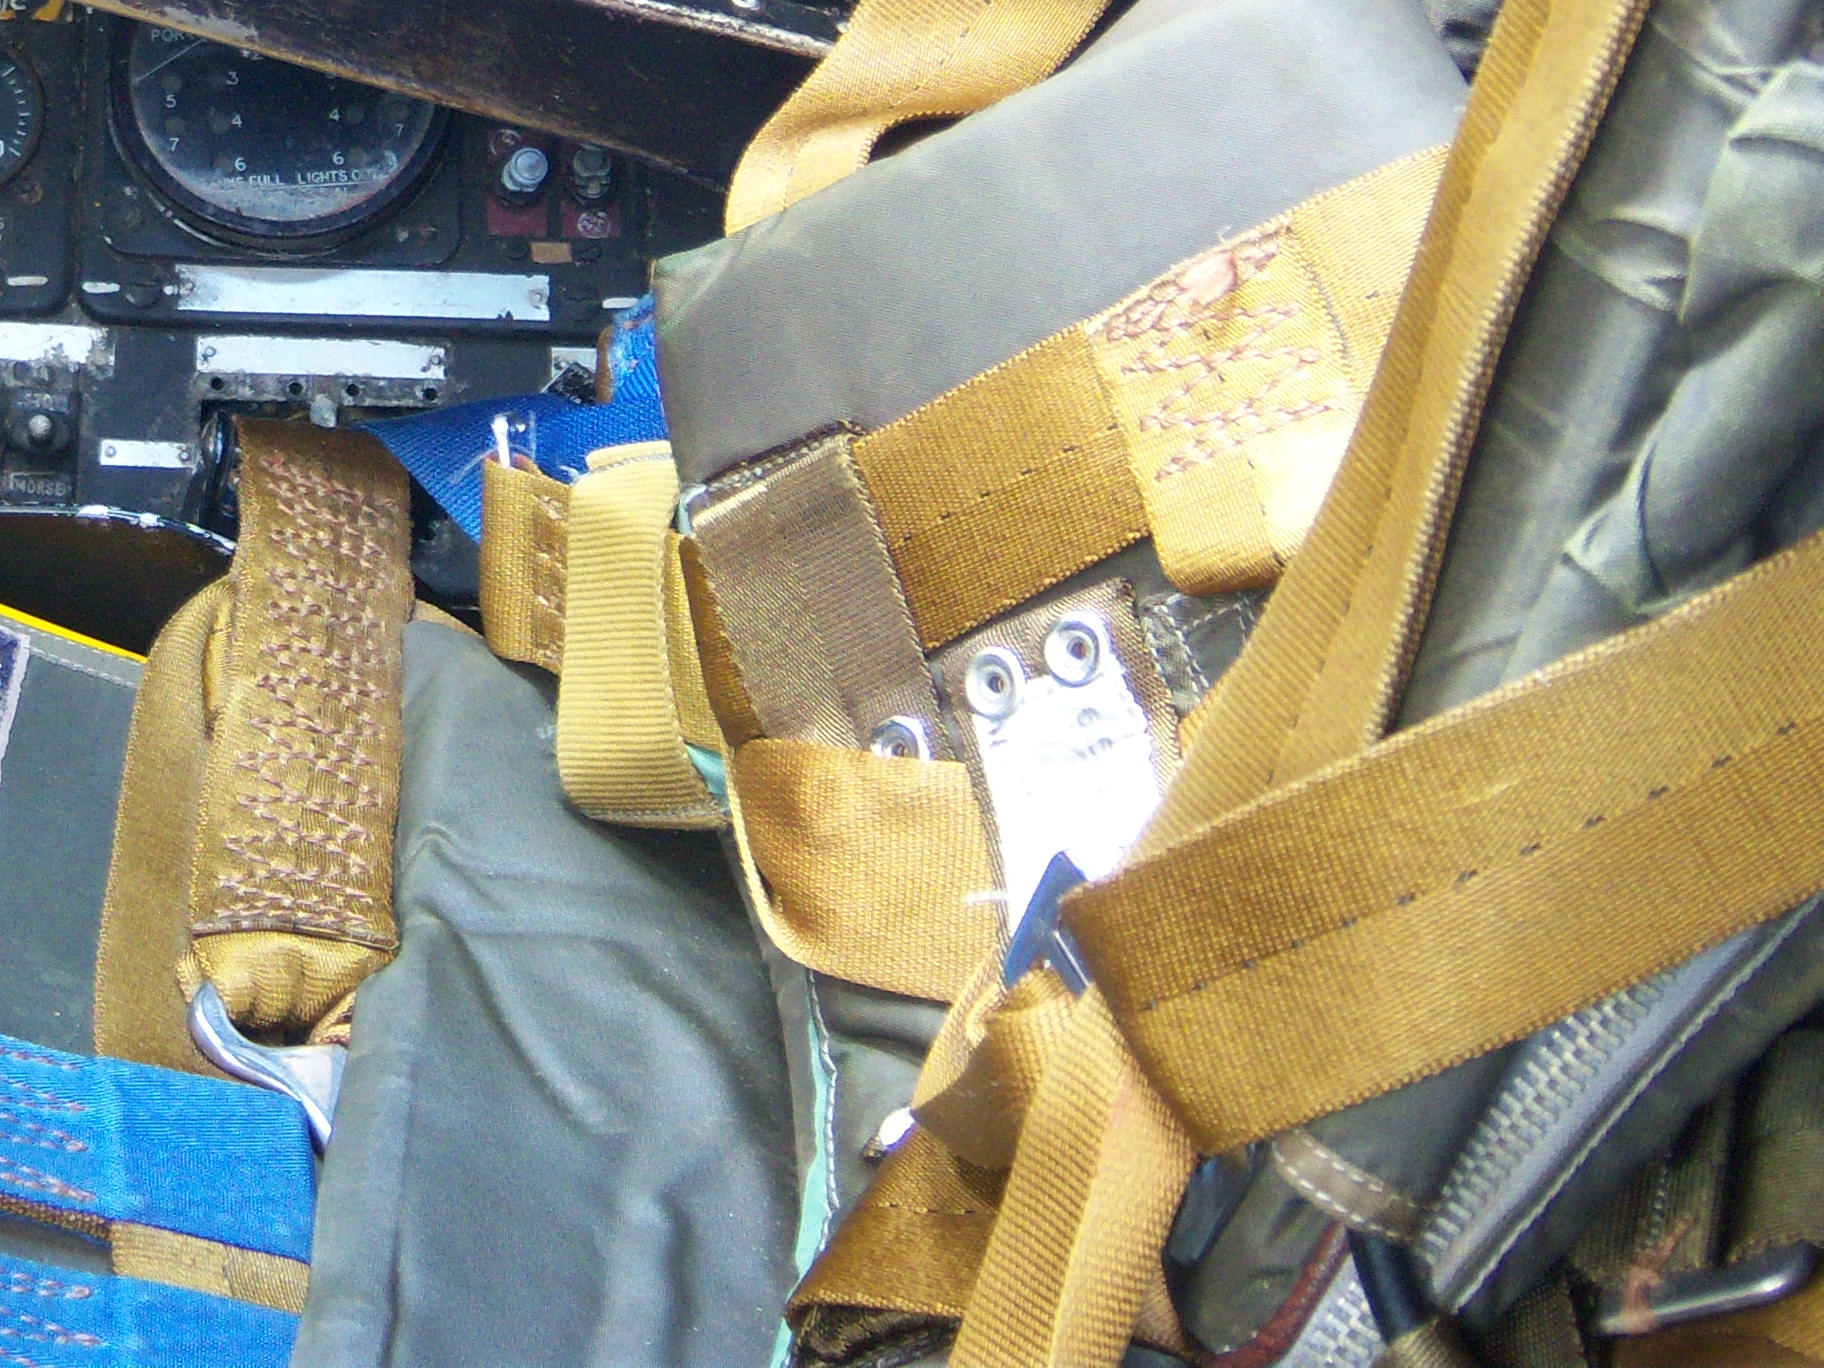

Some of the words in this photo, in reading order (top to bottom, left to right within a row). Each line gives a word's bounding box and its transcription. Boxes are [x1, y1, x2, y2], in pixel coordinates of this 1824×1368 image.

[226, 71, 239, 87] 3
[165, 94, 177, 109] 5
[231, 114, 243, 129] 4
[328, 108, 341, 123] 4
[394, 123, 405, 137] 7
[169, 137, 180, 152] 7
[234, 156, 247, 172] 6
[333, 150, 345, 166] 6
[297, 169, 349, 185] LIGHTS
